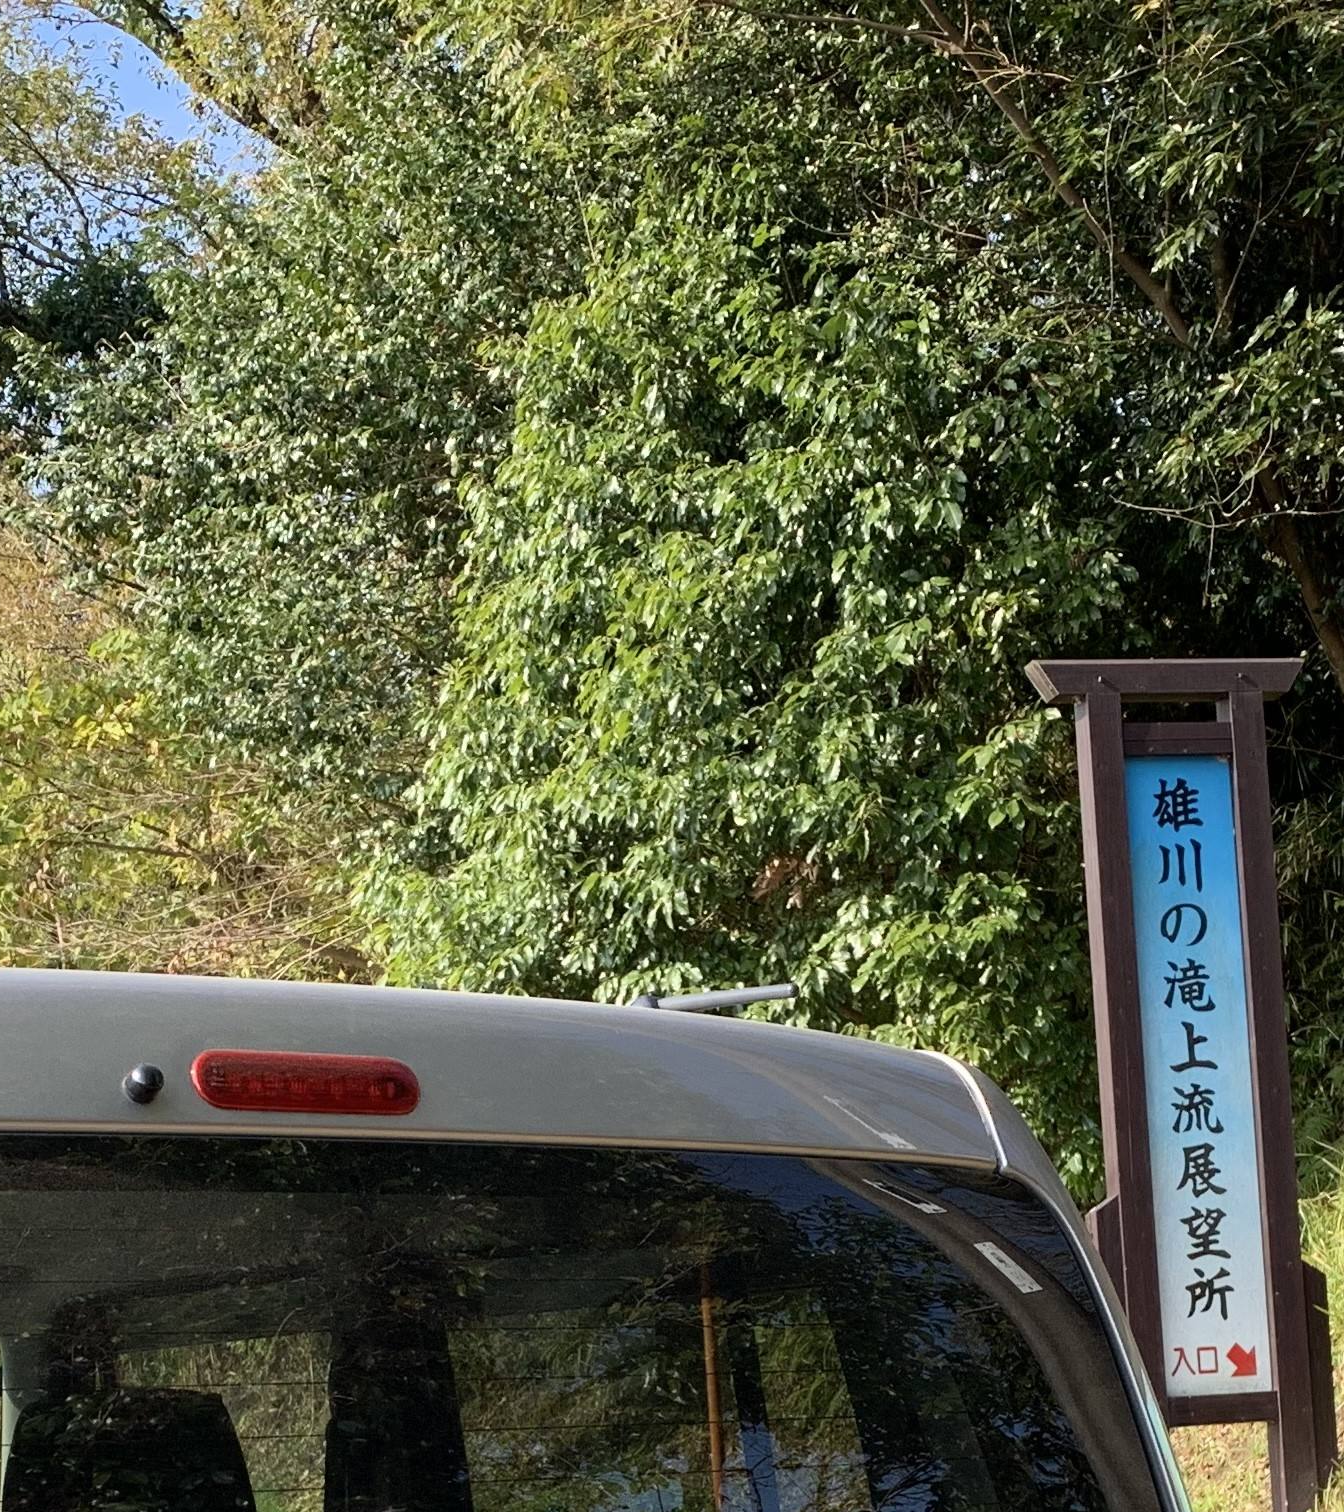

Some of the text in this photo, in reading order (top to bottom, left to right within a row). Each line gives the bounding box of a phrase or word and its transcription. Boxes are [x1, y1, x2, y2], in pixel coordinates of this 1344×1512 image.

[1152, 777, 1234, 1322] 雄川の滝上流展望所
[1172, 1346, 1219, 1377] 入口
